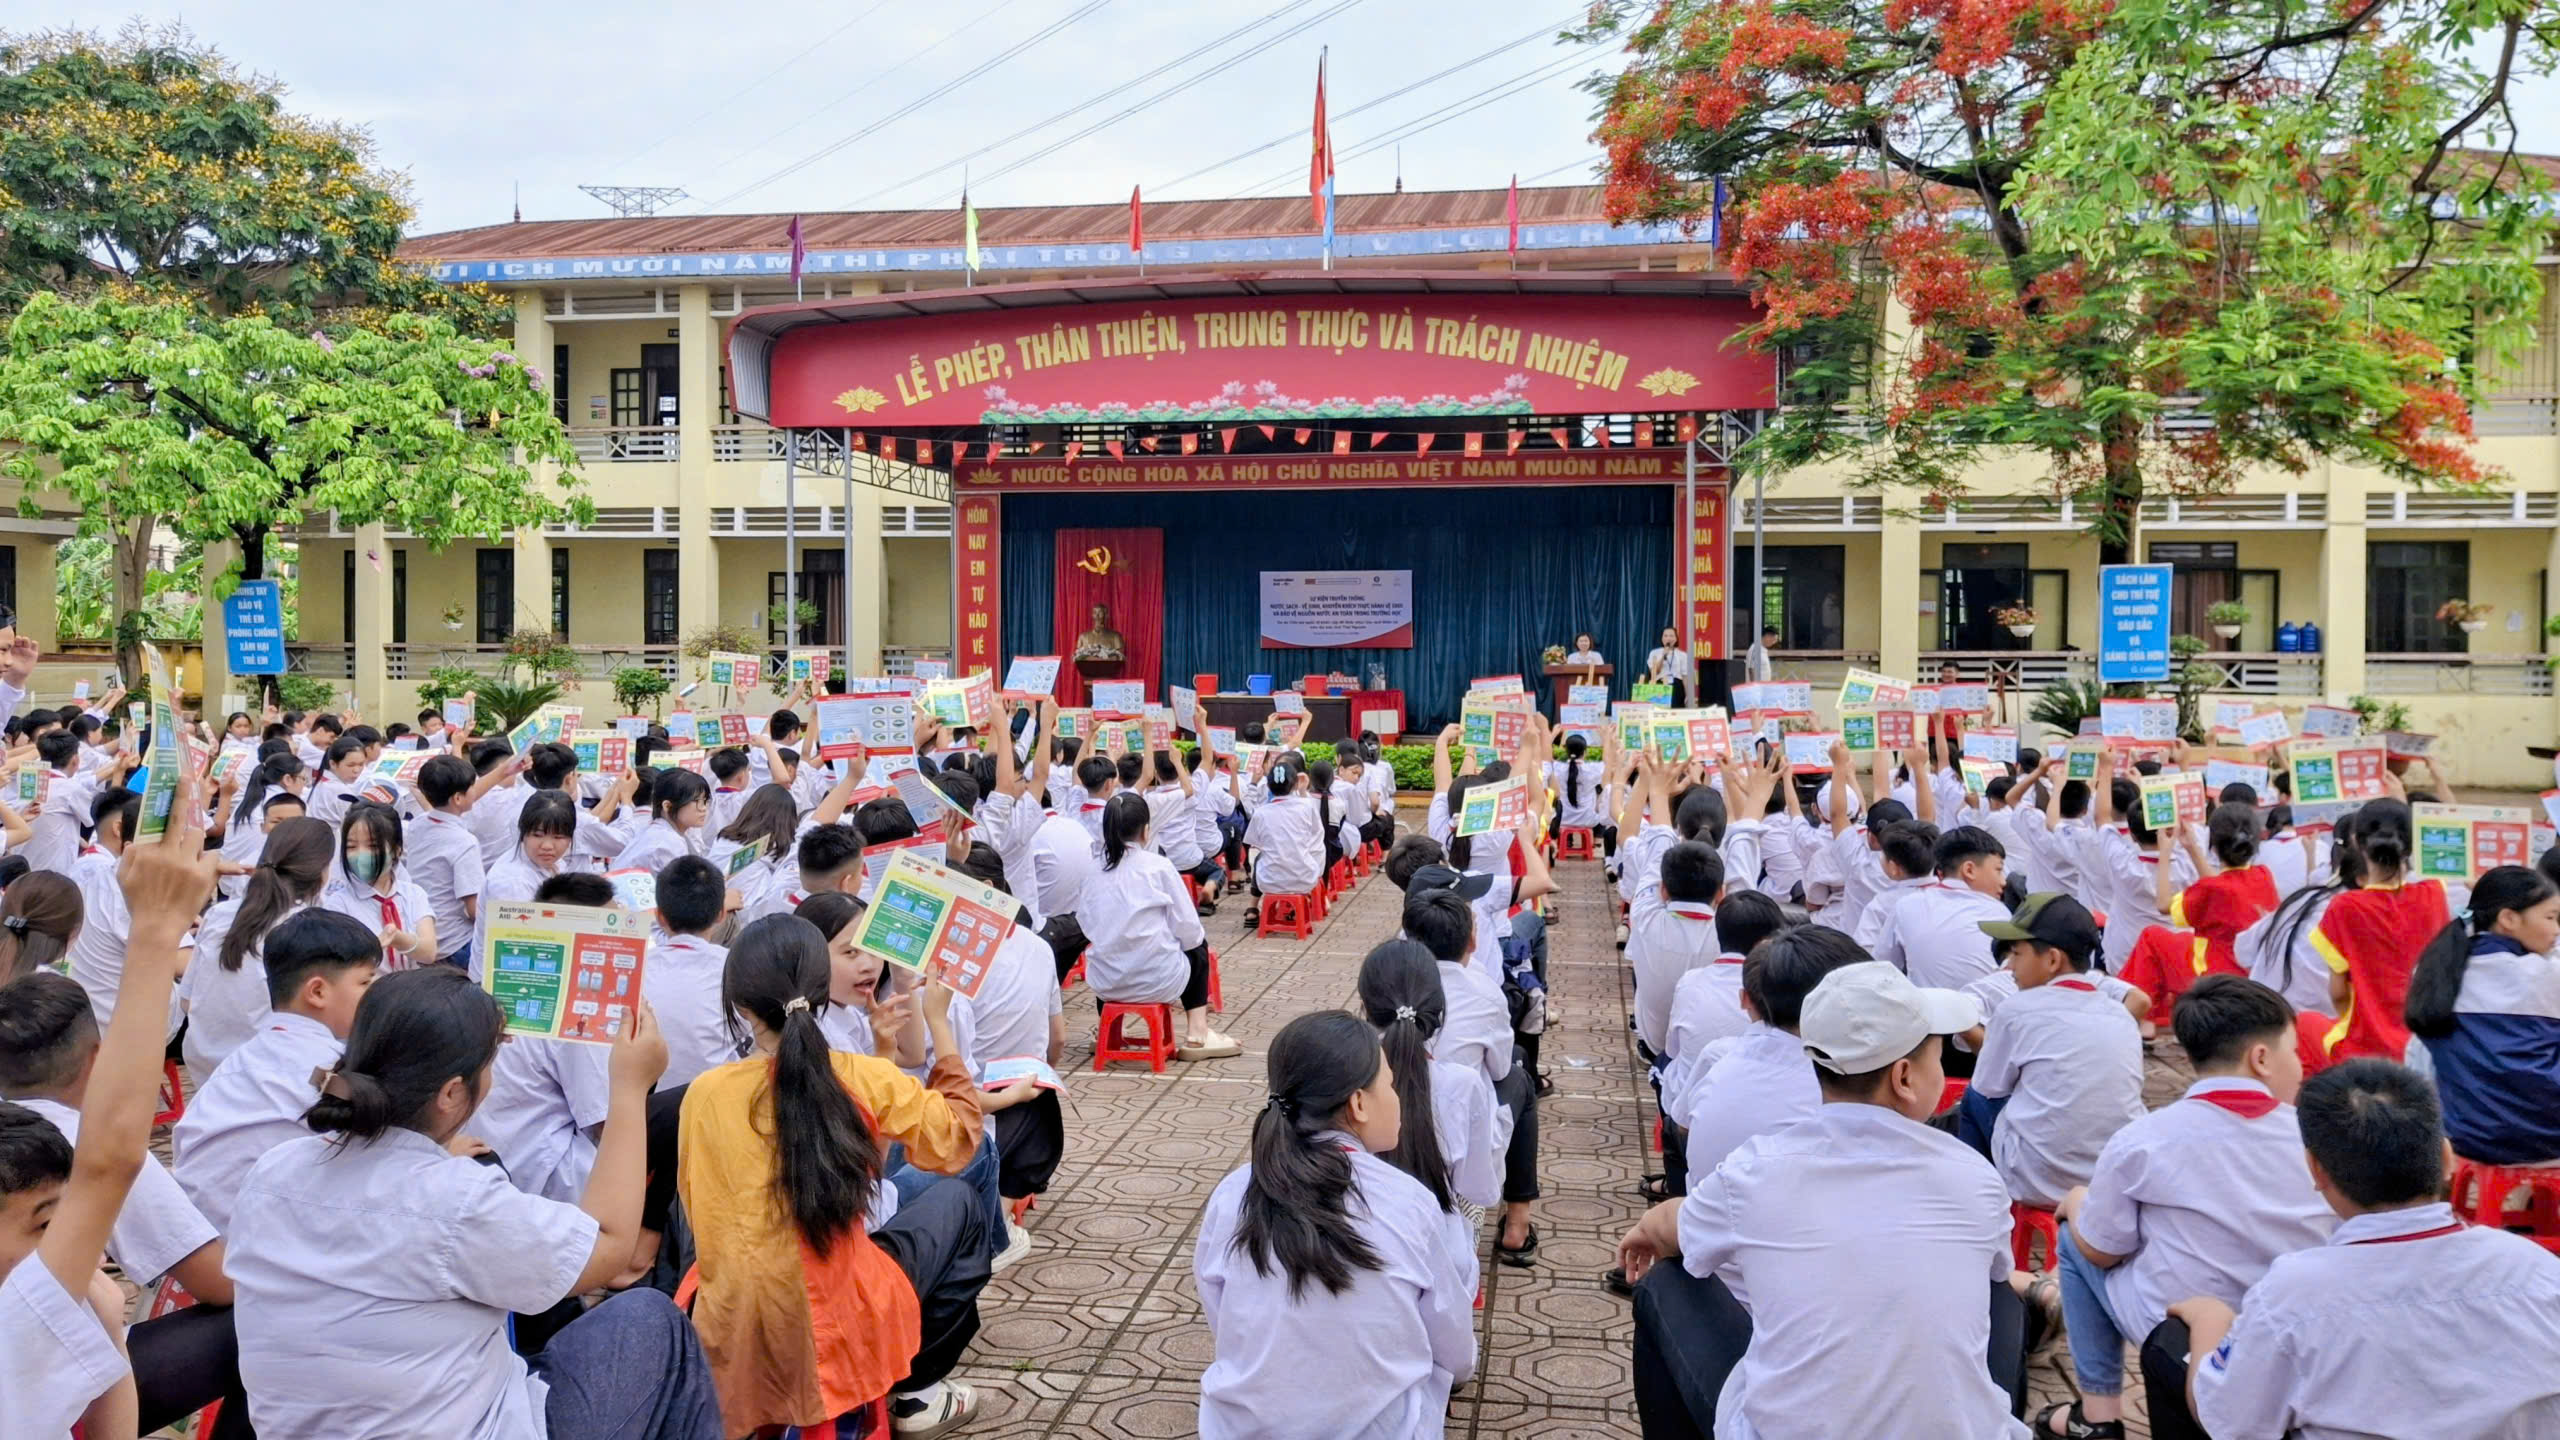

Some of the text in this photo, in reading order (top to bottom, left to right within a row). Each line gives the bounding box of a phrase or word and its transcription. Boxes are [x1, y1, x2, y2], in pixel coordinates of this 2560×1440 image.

[573, 256, 681, 276] MƯỜI
[818, 250, 888, 269] THÌ
[895, 307, 1629, 407] LỄ PHÉP, THÂN THIỆN, TRUNG THỰC VÀ TRÁCH NHIỆM
[1011, 455, 1661, 487] NƯỚC CỘNG HÒA XÃ HỘI CHỦ NGHĨA VIỆT NAM MUÔN NĂM
[1694, 497, 1716, 518] GÀY
[969, 534, 987, 551] NAY
[970, 560, 985, 577] EM
[1680, 581, 1722, 602] TƯỜNG
[969, 609, 987, 629] HÀO
